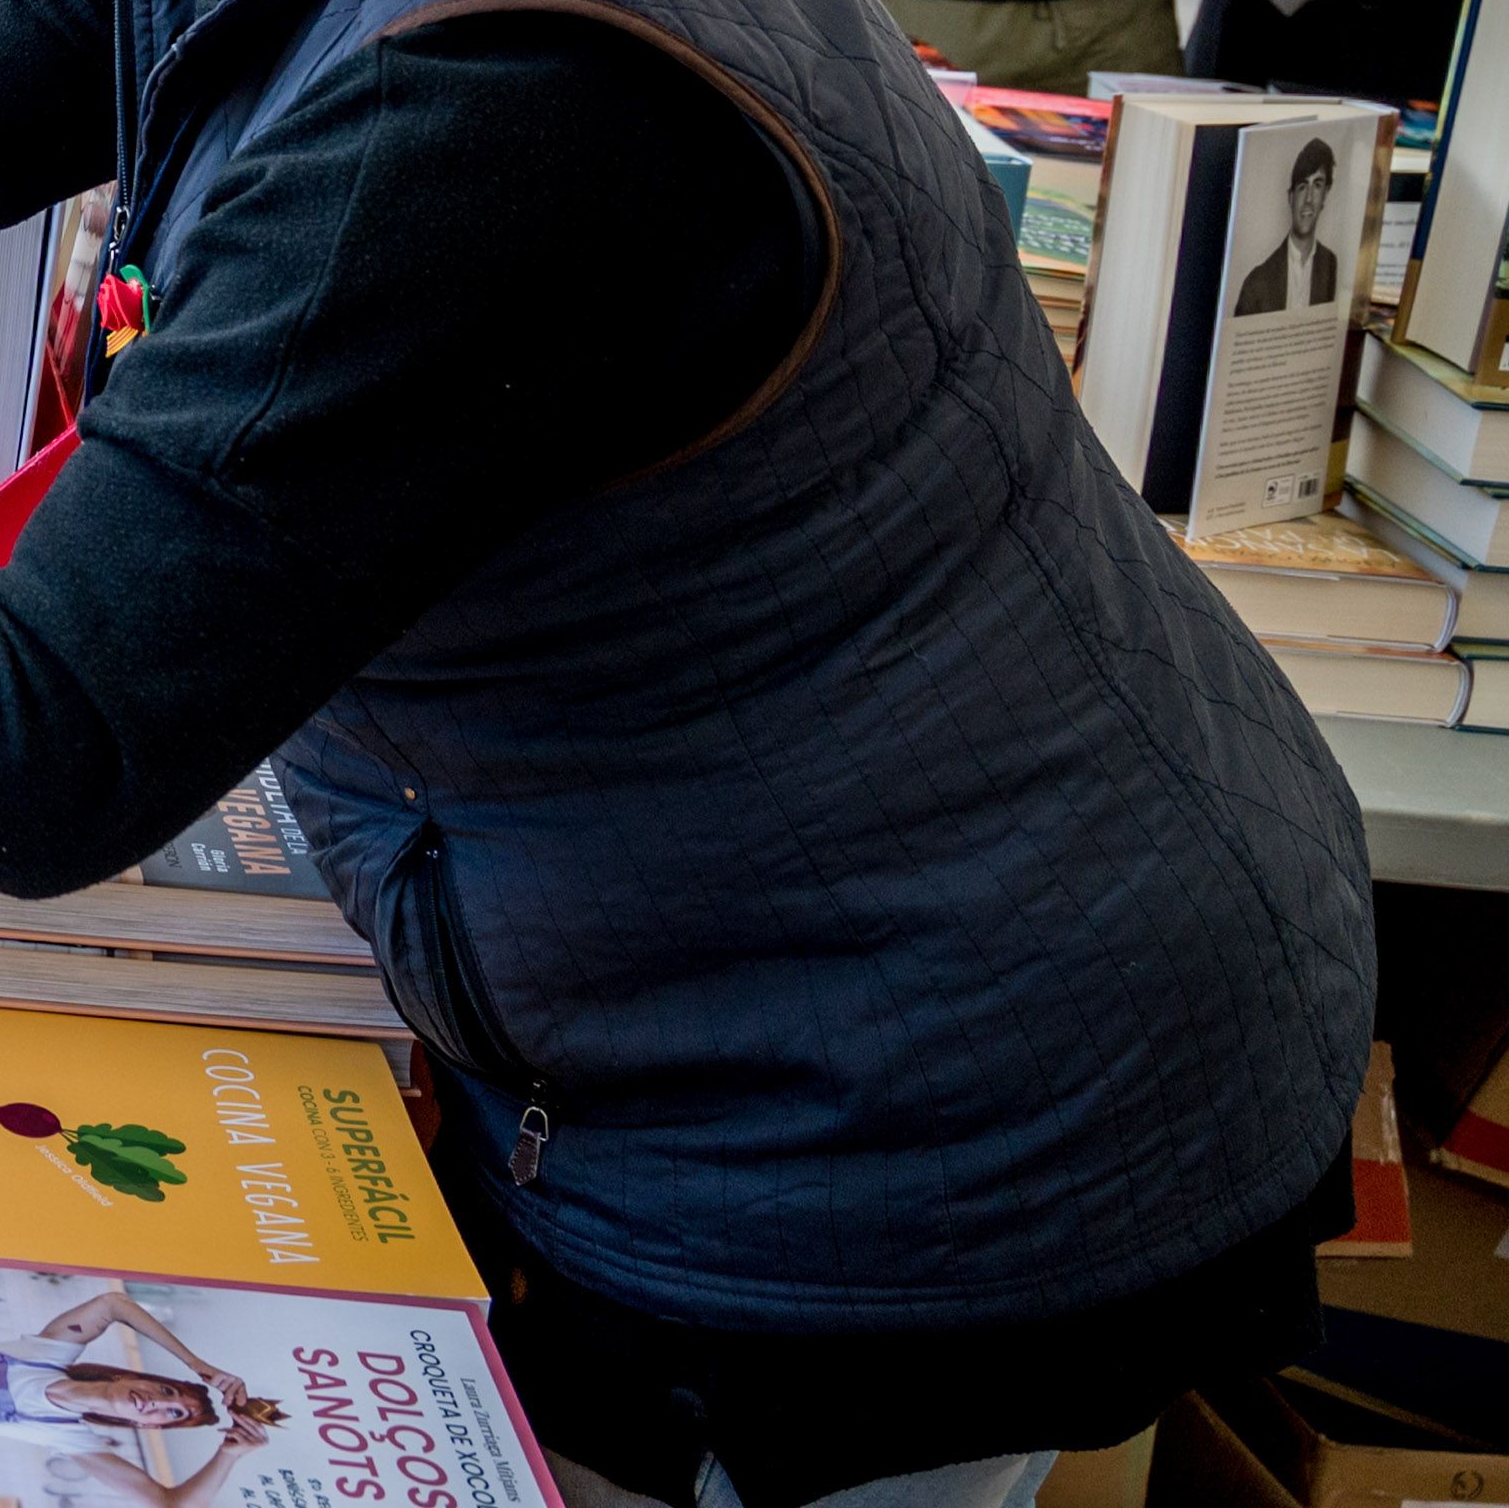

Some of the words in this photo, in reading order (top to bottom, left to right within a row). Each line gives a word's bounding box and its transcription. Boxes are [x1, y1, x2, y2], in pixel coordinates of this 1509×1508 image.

[210, 849, 231, 873] Gloria
[217, 788, 292, 874] VEGANA
[35, 1143, 73, 1175] Jessica
[71, 1173, 116, 1208] Oldfield
[201, 1048, 261, 1147] COCINA
[235, 1162, 322, 1266] VEGANA
[297, 1084, 323, 1127] COCINA
[311, 1127, 330, 1153] CON
[329, 1175, 370, 1244] INGREDIENTES
[322, 1088, 416, 1245] SUPERFÁCIL
[291, 1346, 387, 1501] SANOTS
[357, 1351, 459, 1508] DOLÇOS
[409, 1329, 459, 1427] CROQUETA
[446, 1423, 474, 1447] DE
[460, 1376, 482, 1412] Laura
[475, 1409, 502, 1460] Zurriaga
[495, 1460, 522, 1503] Mitjans
